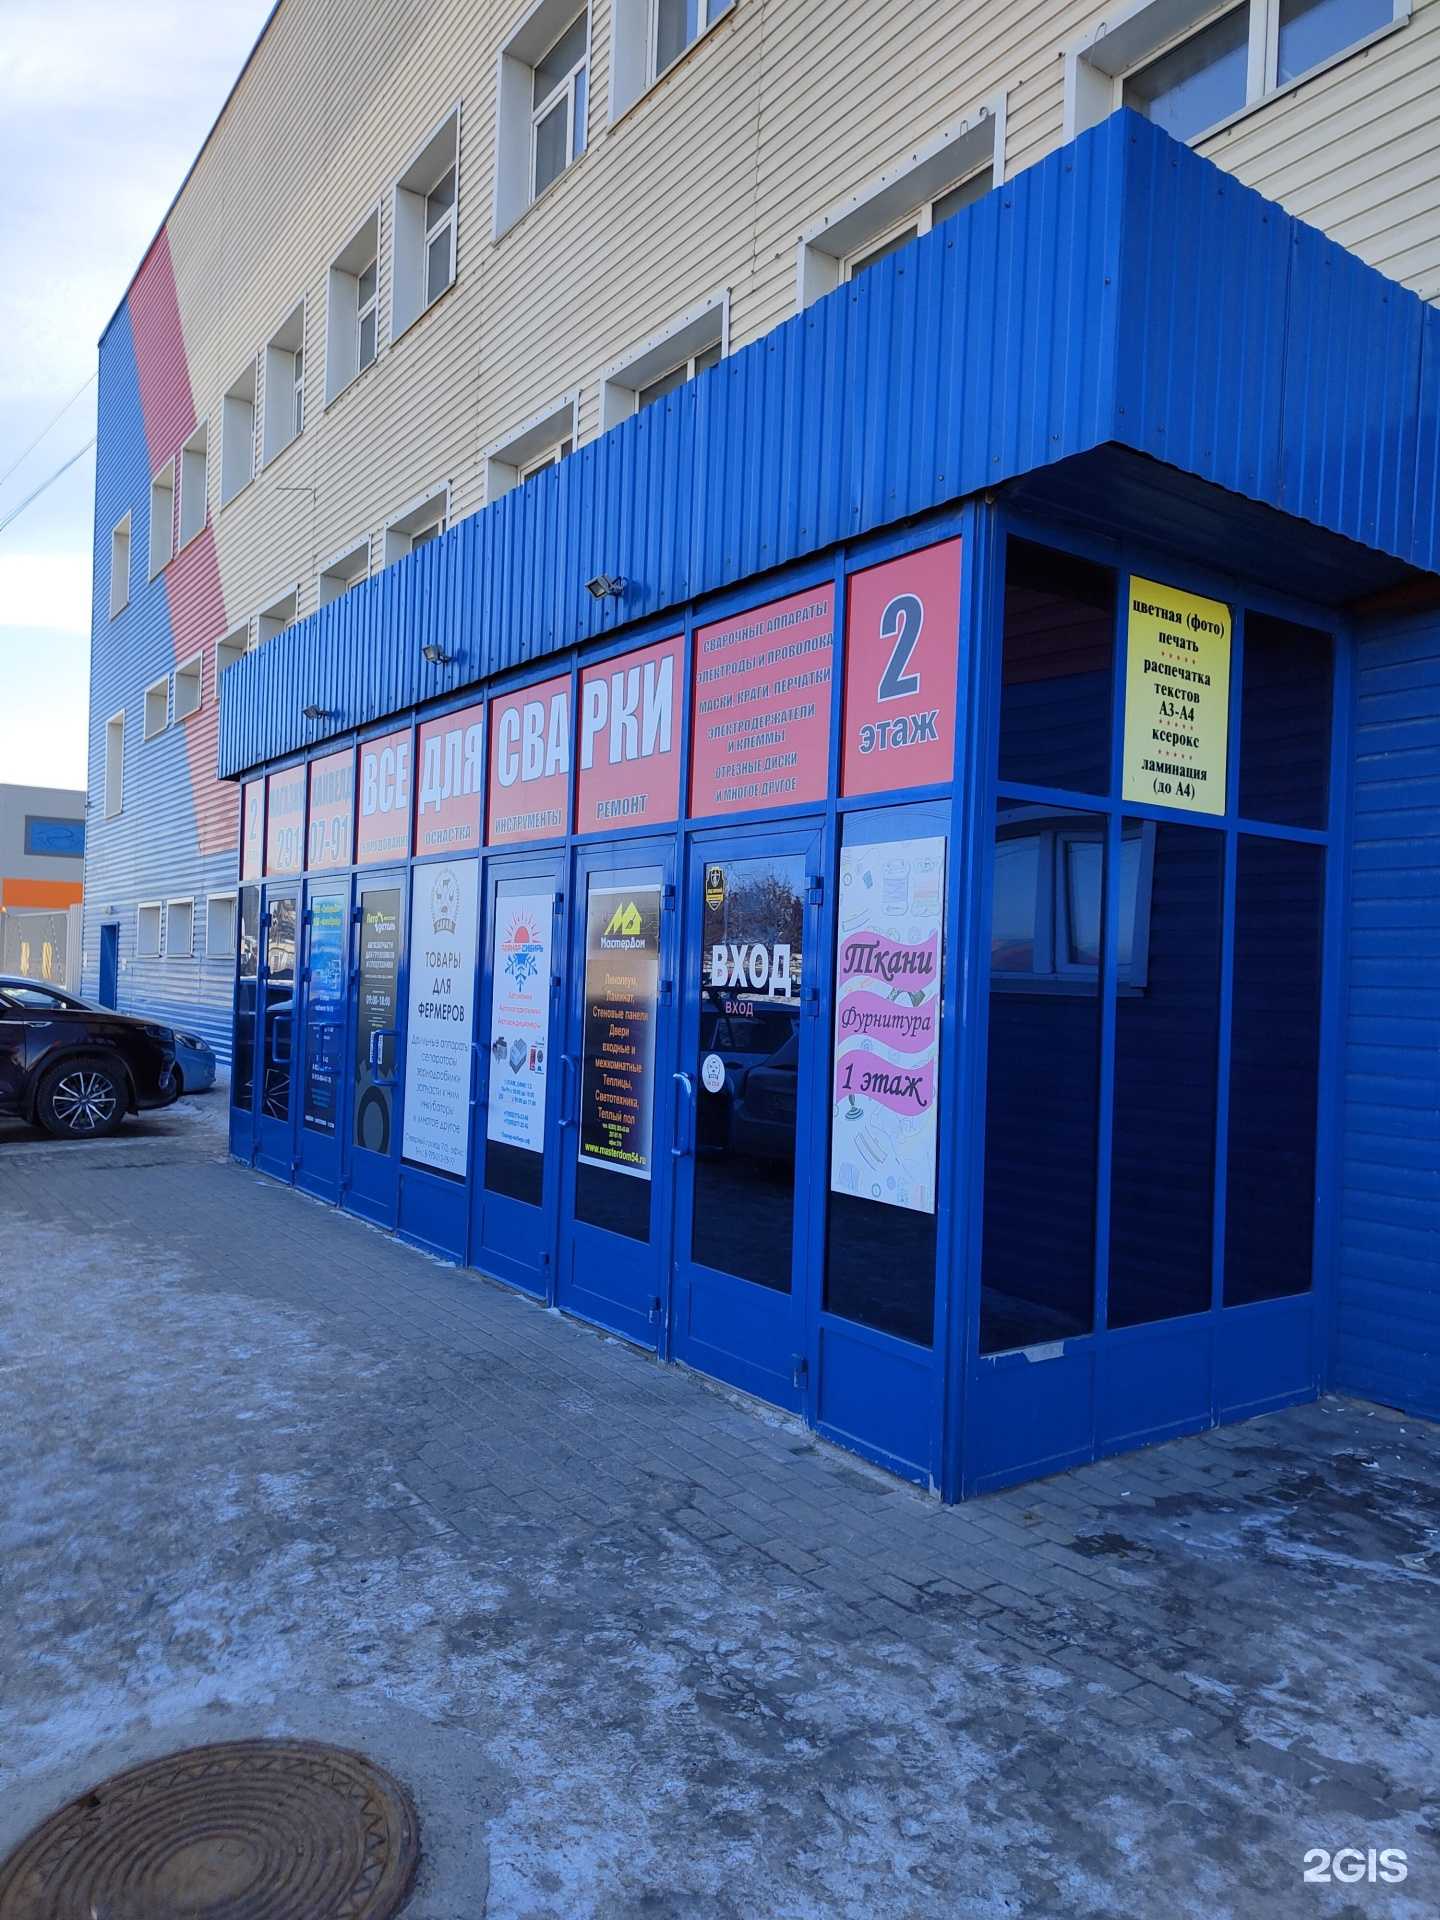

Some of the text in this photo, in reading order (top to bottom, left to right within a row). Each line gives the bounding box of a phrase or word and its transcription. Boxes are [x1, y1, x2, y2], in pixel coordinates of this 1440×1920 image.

[703, 600, 828, 653] СВАРОЧНЫЕ АППАРАТЫ
[1132, 599, 1225, 639] цветная (фото)
[877, 593, 925, 703] 2
[1158, 631, 1199, 653] печать
[697, 632, 833, 684] ЭЛЕКТРОДЫ И ПРОВОЛОКА
[774, 667, 831, 695] ПЕРЧАТКИ
[1143, 658, 1211, 686] распечатка
[1154, 681, 1200, 704] текстов
[707, 703, 816, 740] ЭЛЕКТРОДЕРЖАТЕЛИ
[858, 709, 939, 754] этаж
[728, 730, 785, 753] И КЛЕММЫ
[1152, 727, 1200, 749] ксерокс
[362, 741, 409, 817] ВСЕ
[419, 719, 483, 816] ДЛЯ
[715, 751, 798, 779] ОТРЕЗНЫЕ ДИСКИ
[1141, 758, 1207, 781] ламинация
[715, 777, 797, 802] И МНОГОЕ ДРУГОЕ
[1153, 779, 1172, 795] (до
[494, 808, 563, 833] ИНСТРУМЕНТЫ
[596, 793, 649, 820] РЕМОНТ
[600, 936, 646, 952] МастерДом
[425, 951, 461, 969] ТОВАРЫ
[711, 944, 792, 998] ВХОД
[843, 940, 933, 981] Ткани
[432, 977, 451, 996] ДЛЯ
[418, 1000, 465, 1022] ФЕРМЕРОВ
[592, 1006, 624, 1019] Стеновые
[725, 1001, 754, 1017] ВХОД
[609, 1024, 630, 1038] Двери
[841, 1006, 931, 1038] Фурнитура
[602, 1042, 630, 1056] входные
[843, 1063, 928, 1107] 1 этаж
[597, 1106, 622, 1122] Теплый
